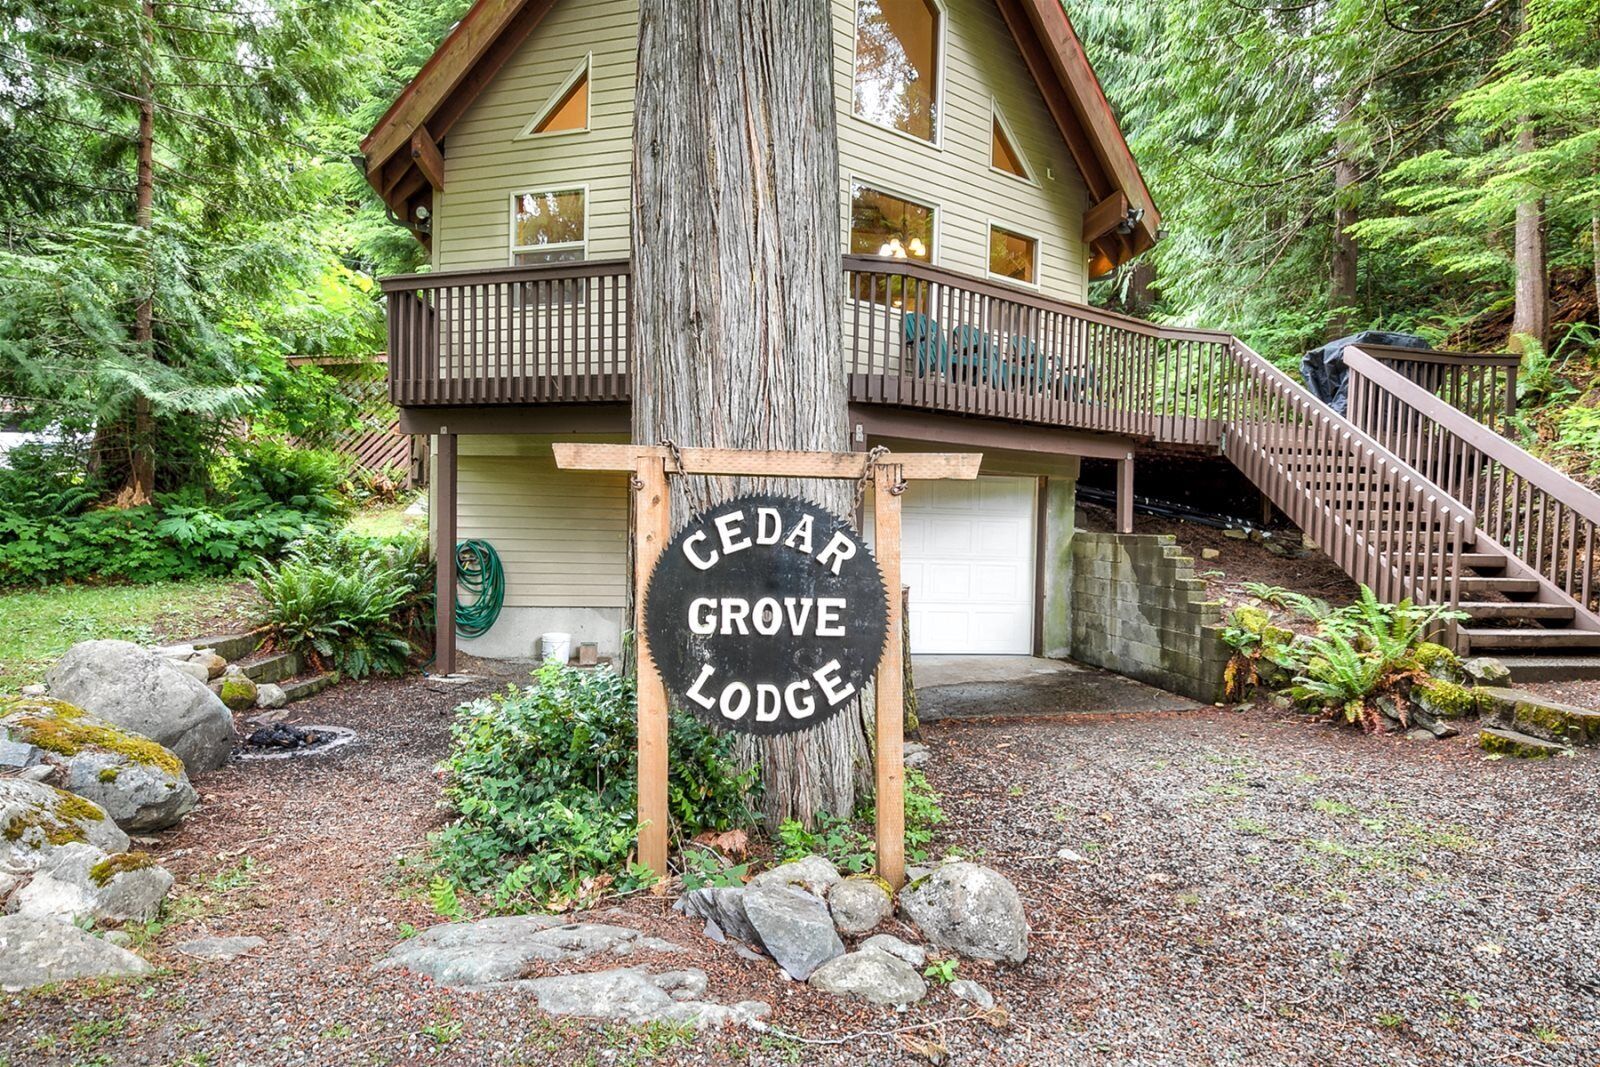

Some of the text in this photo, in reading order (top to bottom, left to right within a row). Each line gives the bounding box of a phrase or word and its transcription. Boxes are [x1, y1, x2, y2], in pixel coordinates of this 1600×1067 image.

[682, 507, 857, 576] CEDAR
[687, 596, 847, 637] GROVE
[686, 658, 856, 722] LODGE
